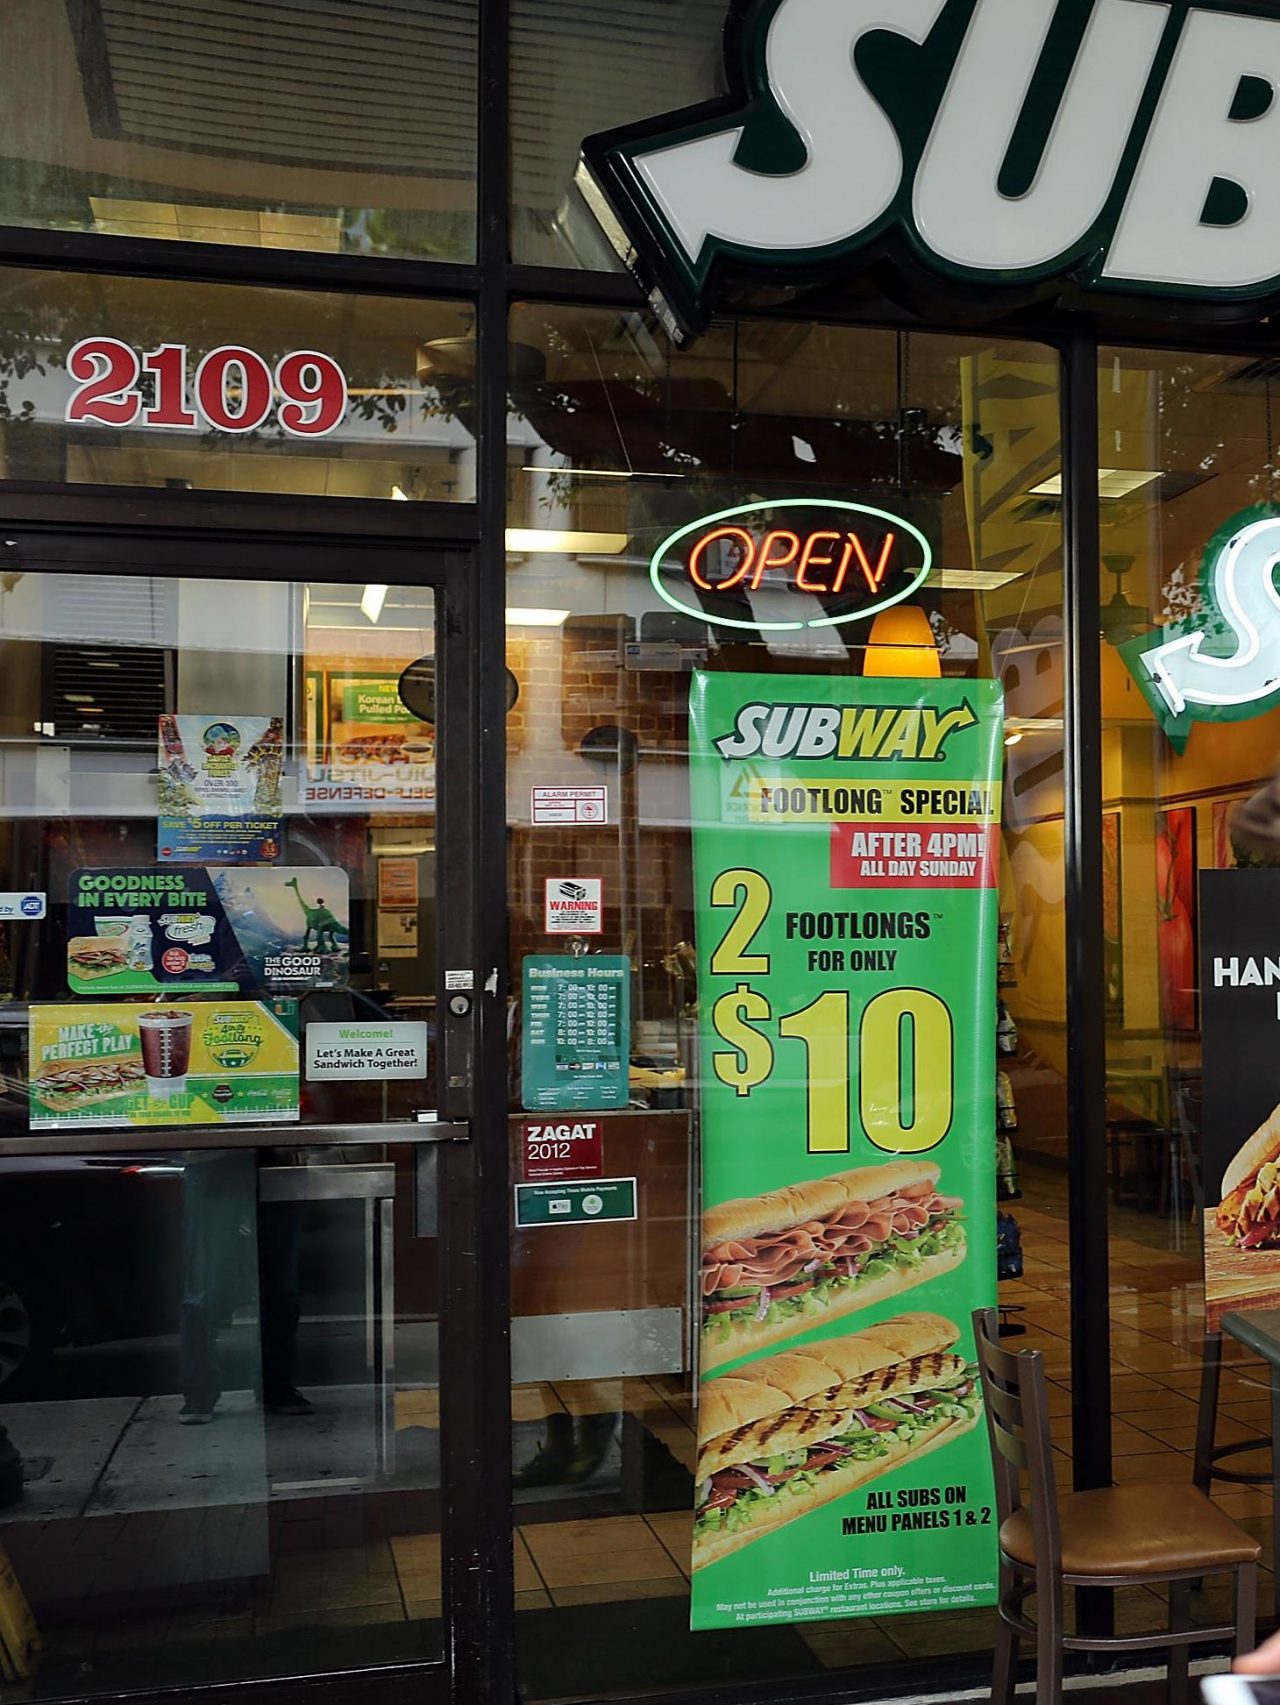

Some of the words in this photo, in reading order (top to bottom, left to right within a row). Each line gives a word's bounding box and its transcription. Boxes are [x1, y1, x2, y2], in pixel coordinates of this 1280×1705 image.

[65, 337, 348, 437] 2109
[690, 527, 894, 593] OPEN
[358, 695, 394, 704] Korean
[360, 705, 393, 713] Pulled
[713, 699, 978, 763] SUBWAY
[901, 789, 994, 815] SPECIAL
[852, 832, 921, 857] AFTER
[927, 832, 986, 858] 4PM!
[860, 861, 886, 877] ALL
[888, 860, 917, 877] DAY
[920, 860, 977, 877] SUNDAY
[78, 875, 185, 891] GOODNESS
[78, 892, 95, 907] IN
[103, 891, 163, 907] EVERY
[167, 891, 207, 907] BITE
[550, 902, 598, 911] WARNING
[710, 867, 772, 975] 2
[265, 957, 281, 965] THE
[282, 956, 321, 966] GOOD
[808, 950, 844, 972] FOR
[850, 950, 897, 971] ONLY
[264, 967, 321, 976] DINOSAUR
[528, 968, 586, 978] Business
[587, 967, 624, 978] Hours
[58, 1023, 94, 1042] MAKE
[338, 1029, 393, 1038] Welcome!
[42, 1038, 99, 1061] PERFECT
[102, 1034, 132, 1053] PLAY
[317, 1049, 341, 1058] Let's
[344, 1048, 373, 1058] Make
[375, 1048, 383, 1057] A
[386, 1048, 415, 1057] Great
[314, 1059, 365, 1069] Sandwich
[367, 1058, 418, 1069] Together!
[712, 982, 954, 1155] $10
[527, 1124, 597, 1142] ZAGAT
[528, 1143, 571, 1160] 2012
[866, 1491, 894, 1510] ALL
[897, 1487, 941, 1508] SUBS
[944, 1485, 966, 1504] ON
[842, 1514, 887, 1535] MENU
[891, 1510, 950, 1532] PANELS
[953, 1509, 961, 1526] 1
[965, 1511, 977, 1525] &
[980, 1506, 991, 1524] 2
[810, 1569, 849, 1582] Limited
[852, 1567, 878, 1579] Time
[880, 1565, 906, 1577] only.
[767, 1586, 804, 1597] Additional
[806, 1584, 831, 1593] charge
[832, 1583, 843, 1591] for
[870, 1580, 886, 1588] Plus
[888, 1577, 924, 1588] applicable
[716, 1603, 732, 1612] May
[734, 1602, 746, 1610] not
[748, 1601, 757, 1609] be
[759, 1600, 776, 1608] used
[786, 1596, 829, 1606] conjunction
[831, 1594, 846, 1602] with
[863, 1591, 881, 1599] other
[883, 1590, 909, 1599] coupon
[911, 1587, 932, 1596] offers
[942, 1583, 972, 1593] discount
[746, 1609, 792, 1620] participating
[830, 1603, 868, 1613] restaurant
[869, 1601, 903, 1610] locations.
[904, 1599, 918, 1607] See
[919, 1597, 938, 1605] store
[939, 1596, 949, 1604] for
[950, 1594, 976, 1603] details.
